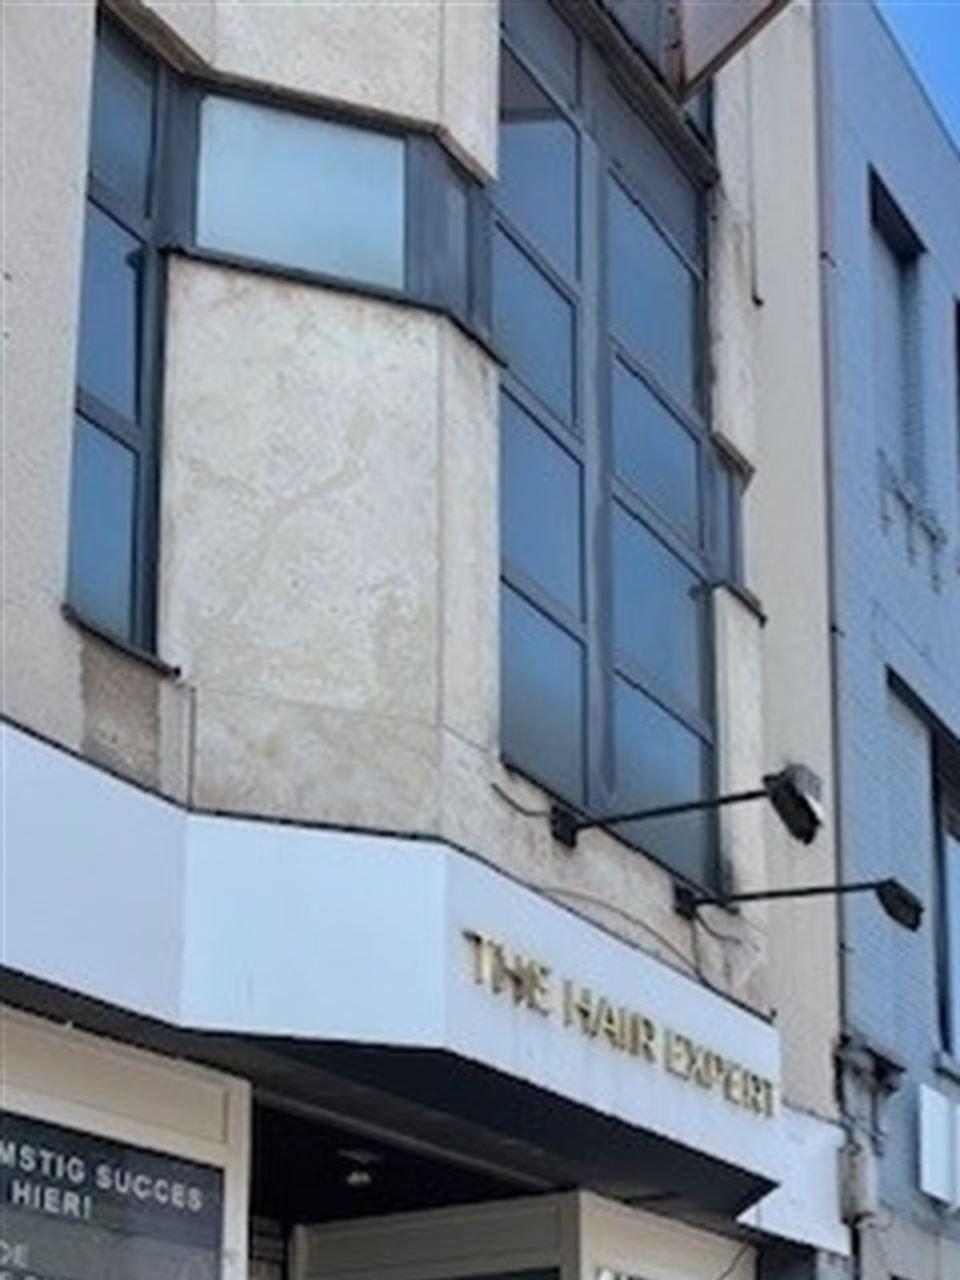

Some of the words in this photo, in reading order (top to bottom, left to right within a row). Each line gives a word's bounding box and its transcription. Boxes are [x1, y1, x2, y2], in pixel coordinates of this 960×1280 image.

[462, 929, 550, 1016] THE
[562, 979, 655, 1063] HAIR
[664, 1029, 774, 1117] EXPERT
[96, 1164, 203, 1211] SUCCES
